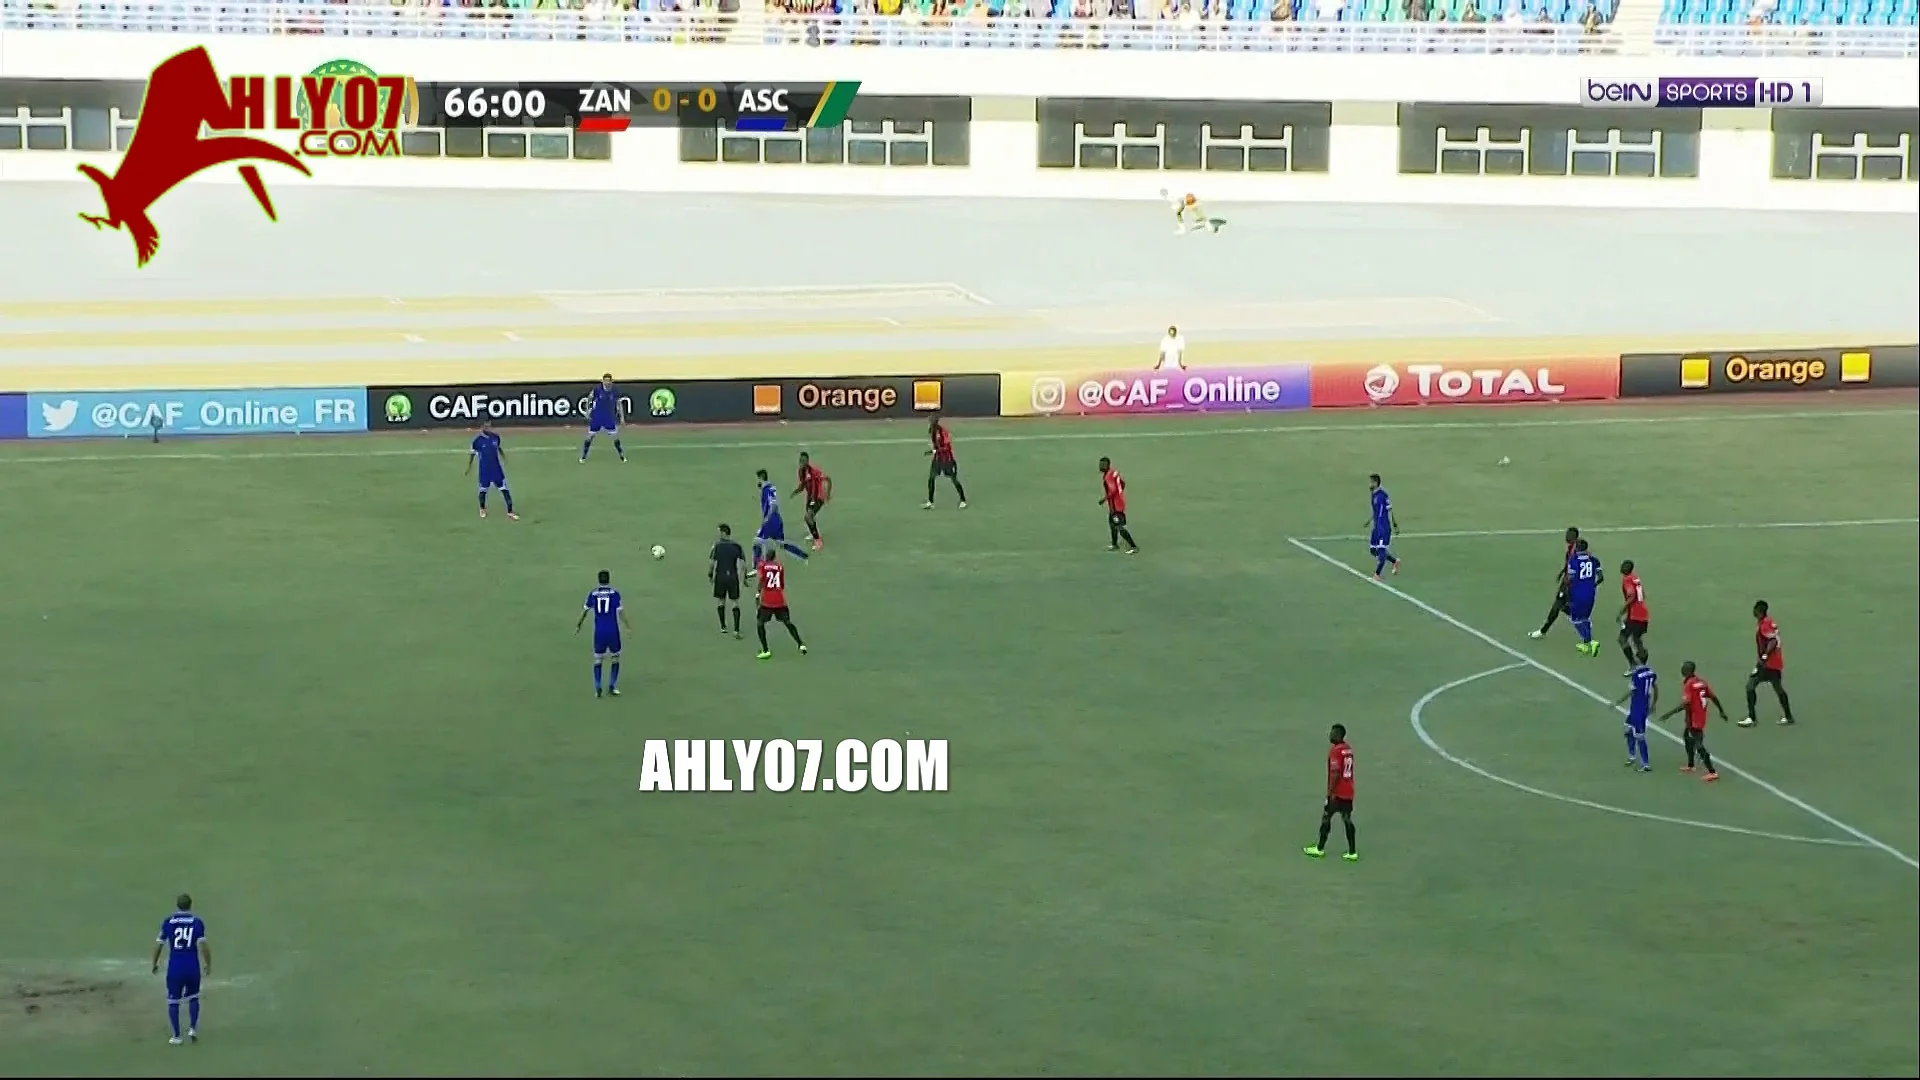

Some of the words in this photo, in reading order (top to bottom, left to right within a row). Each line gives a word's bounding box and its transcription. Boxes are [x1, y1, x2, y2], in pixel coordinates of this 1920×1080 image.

[1726, 357, 1825, 384] Orange
[798, 384, 897, 411] Orange
[1078, 376, 1280, 408] @CAF_Online
[91, 398, 356, 430] @CAF_Online_FR
[766, 571, 780, 588] 24
[1580, 561, 1593, 579] 28
[597, 597, 610, 613] 17
[174, 927, 193, 949] 24
